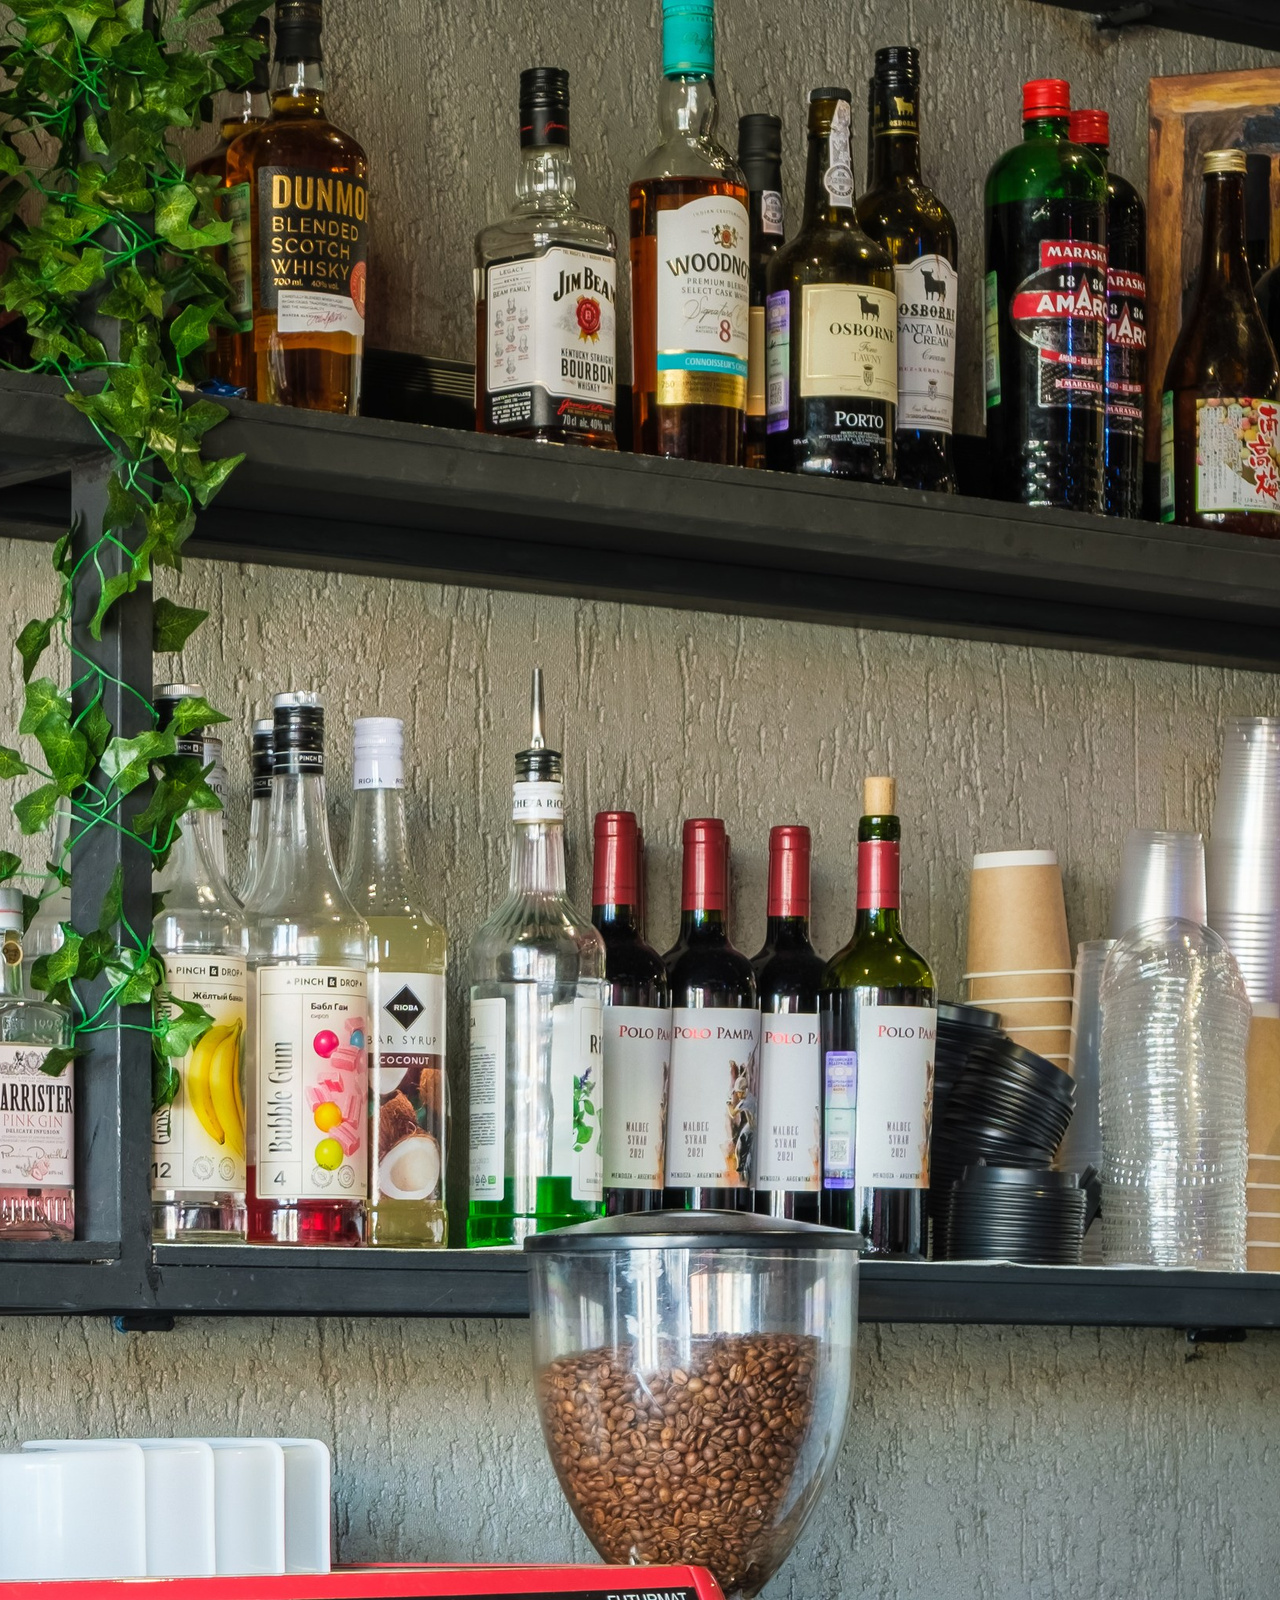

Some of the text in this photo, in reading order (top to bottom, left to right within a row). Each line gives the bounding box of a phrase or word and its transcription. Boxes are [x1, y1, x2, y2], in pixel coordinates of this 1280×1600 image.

[272, 216, 359, 242] BLENDED
[271, 237, 350, 260] SCOTCH
[1047, 245, 1107, 263] MARASKA
[271, 258, 349, 280] WHISKY
[499, 267, 525, 276] LEGACY
[274, 278, 291, 287] 700
[553, 269, 581, 302] JIM
[687, 278, 725, 287] PREMIUM
[1058, 274, 1104, 293] 18 86
[509, 285, 531, 294] FAMILY
[681, 287, 732, 298] SELECT CASK
[719, 319, 731, 343] 8
[829, 321, 895, 344] OSBORNE
[914, 332, 949, 348] CREAM
[851, 351, 882, 365] TAWNY
[561, 358, 614, 385] BOURBON
[577, 381, 601, 394] WHISKEY
[834, 410, 884, 429] PORTO
[176, 966, 240, 979] PINCH DROP
[294, 978, 360, 988] PINCH DROP
[310, 1002, 333, 1012] Бабл
[393, 1004, 419, 1012] RIOBA
[619, 1025, 655, 1040] POLO
[673, 1026, 754, 1041] POLO PAMPA
[764, 1031, 803, 1045] POLO
[878, 1025, 915, 1039] POLO
[367, 1036, 437, 1047] BAR SYRUP
[380, 1056, 430, 1066] COCONUT
[267, 1041, 293, 1154] Bubble Gum
[3, 1114, 63, 1128] PINK GIN
[682, 1121, 710, 1132] MALBEC
[887, 1121, 911, 1133] MALBEC
[626, 1122, 649, 1134] MALBEC
[773, 1126, 799, 1136] MALBEC
[627, 1135, 648, 1146] SYRAH
[684, 1134, 707, 1145] SYRAH
[774, 1139, 797, 1149] SYRAH
[888, 1135, 909, 1146] SYRAH
[629, 1149, 645, 1159] 2021
[687, 1148, 704, 1158] 2021
[777, 1151, 794, 1162] 2021
[891, 1148, 907, 1159] 2021
[151, 1162, 172, 1179] 12
[273, 1170, 287, 1187] 4
